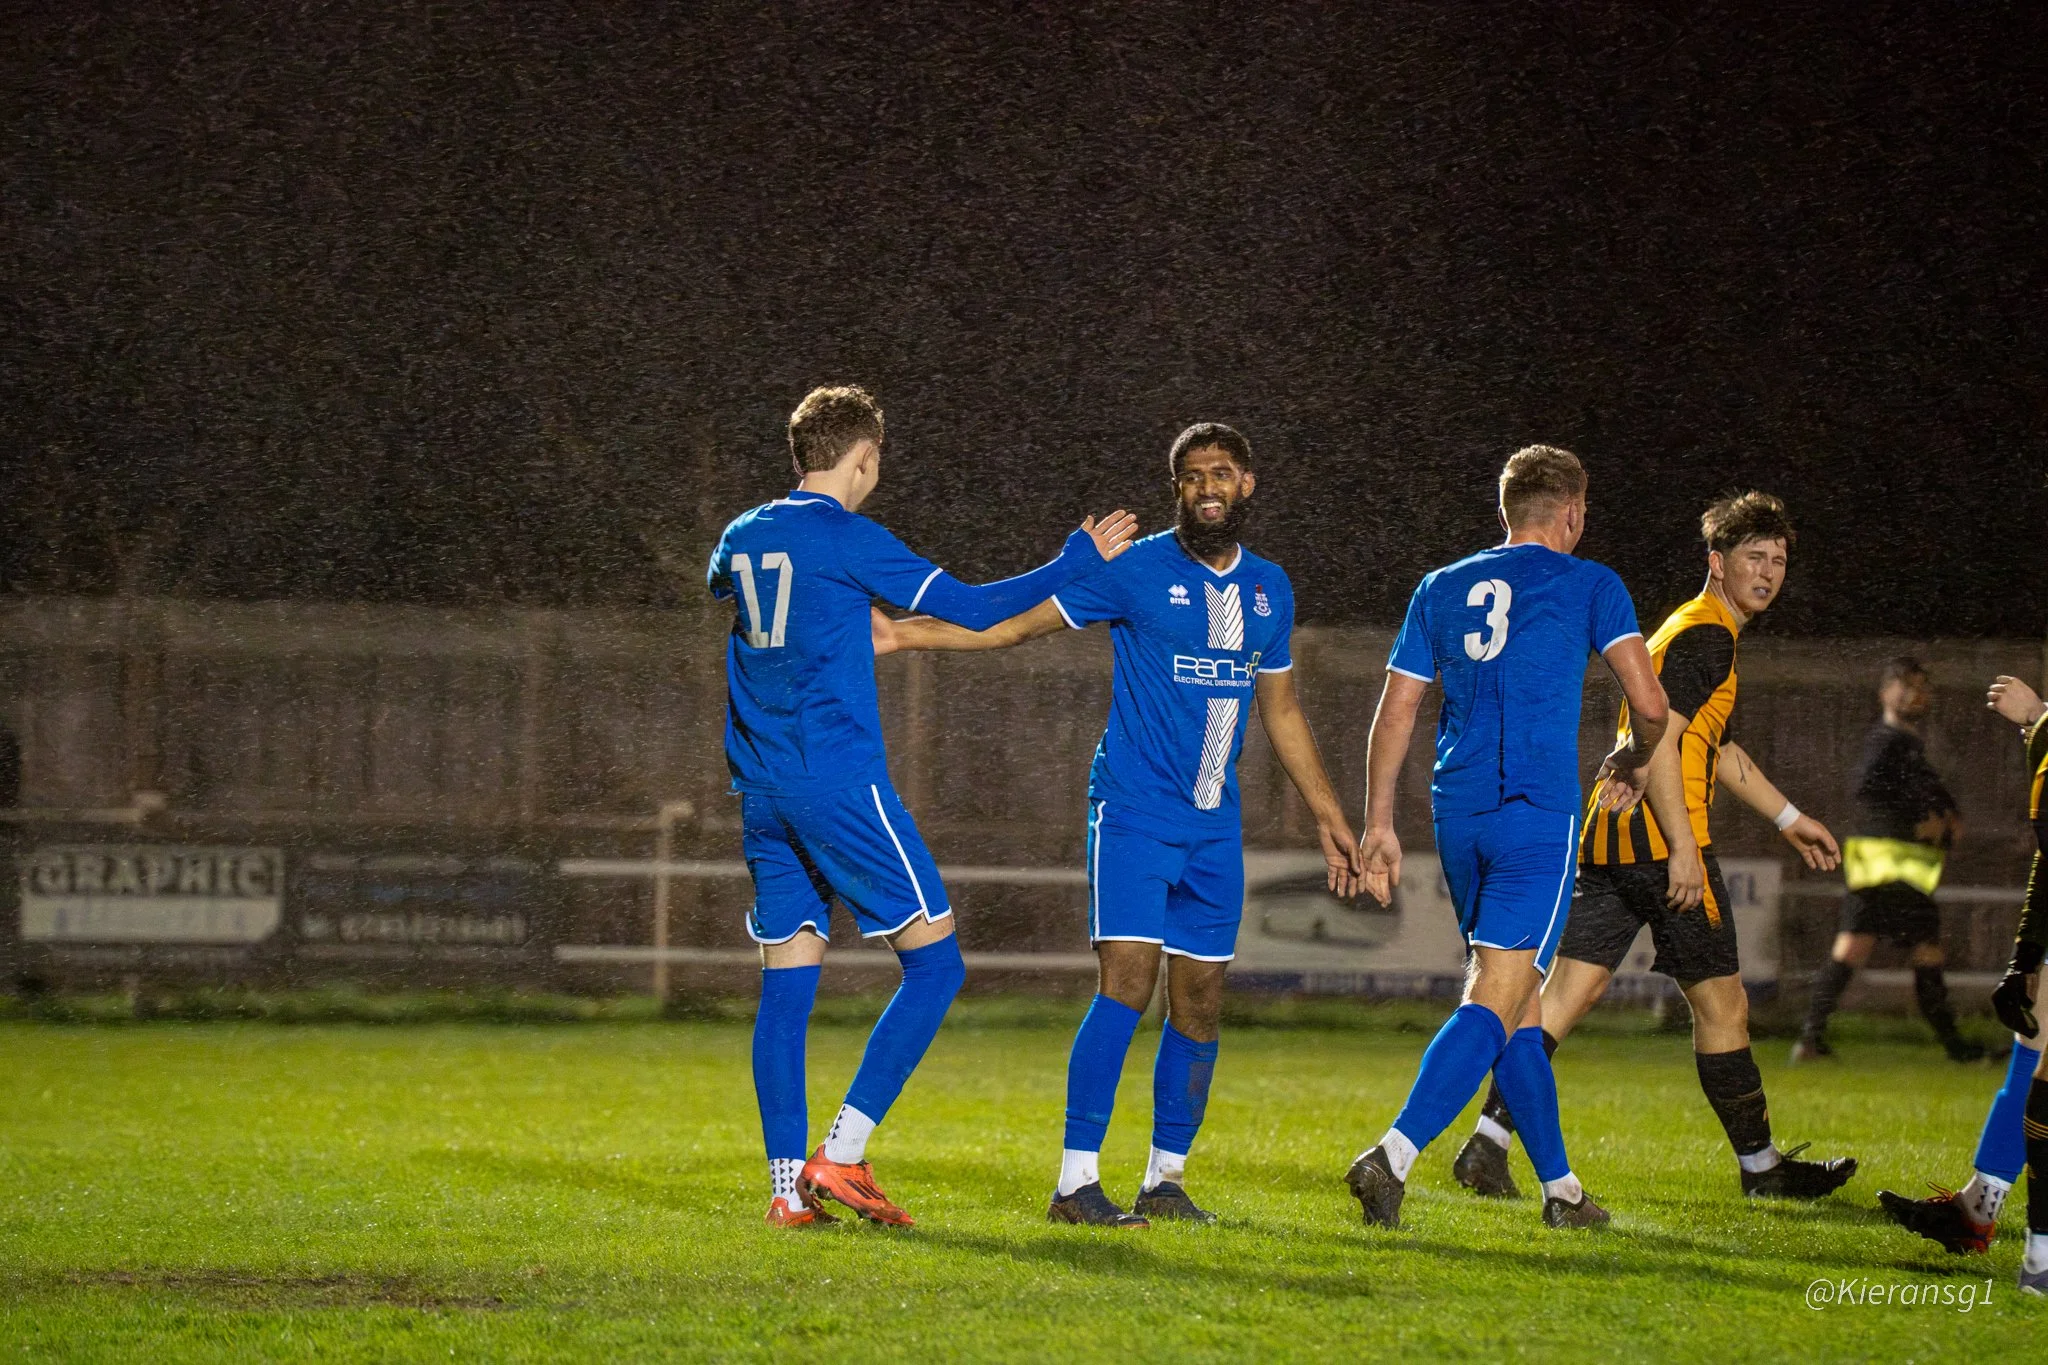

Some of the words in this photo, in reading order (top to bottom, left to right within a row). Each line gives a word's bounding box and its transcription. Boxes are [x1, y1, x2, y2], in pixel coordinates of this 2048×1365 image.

[731, 552, 794, 649] 17
[1464, 578, 1513, 662] 3
[1174, 674, 1214, 687] ELECTRICAL
[36, 854, 274, 895] GRAPHIC
